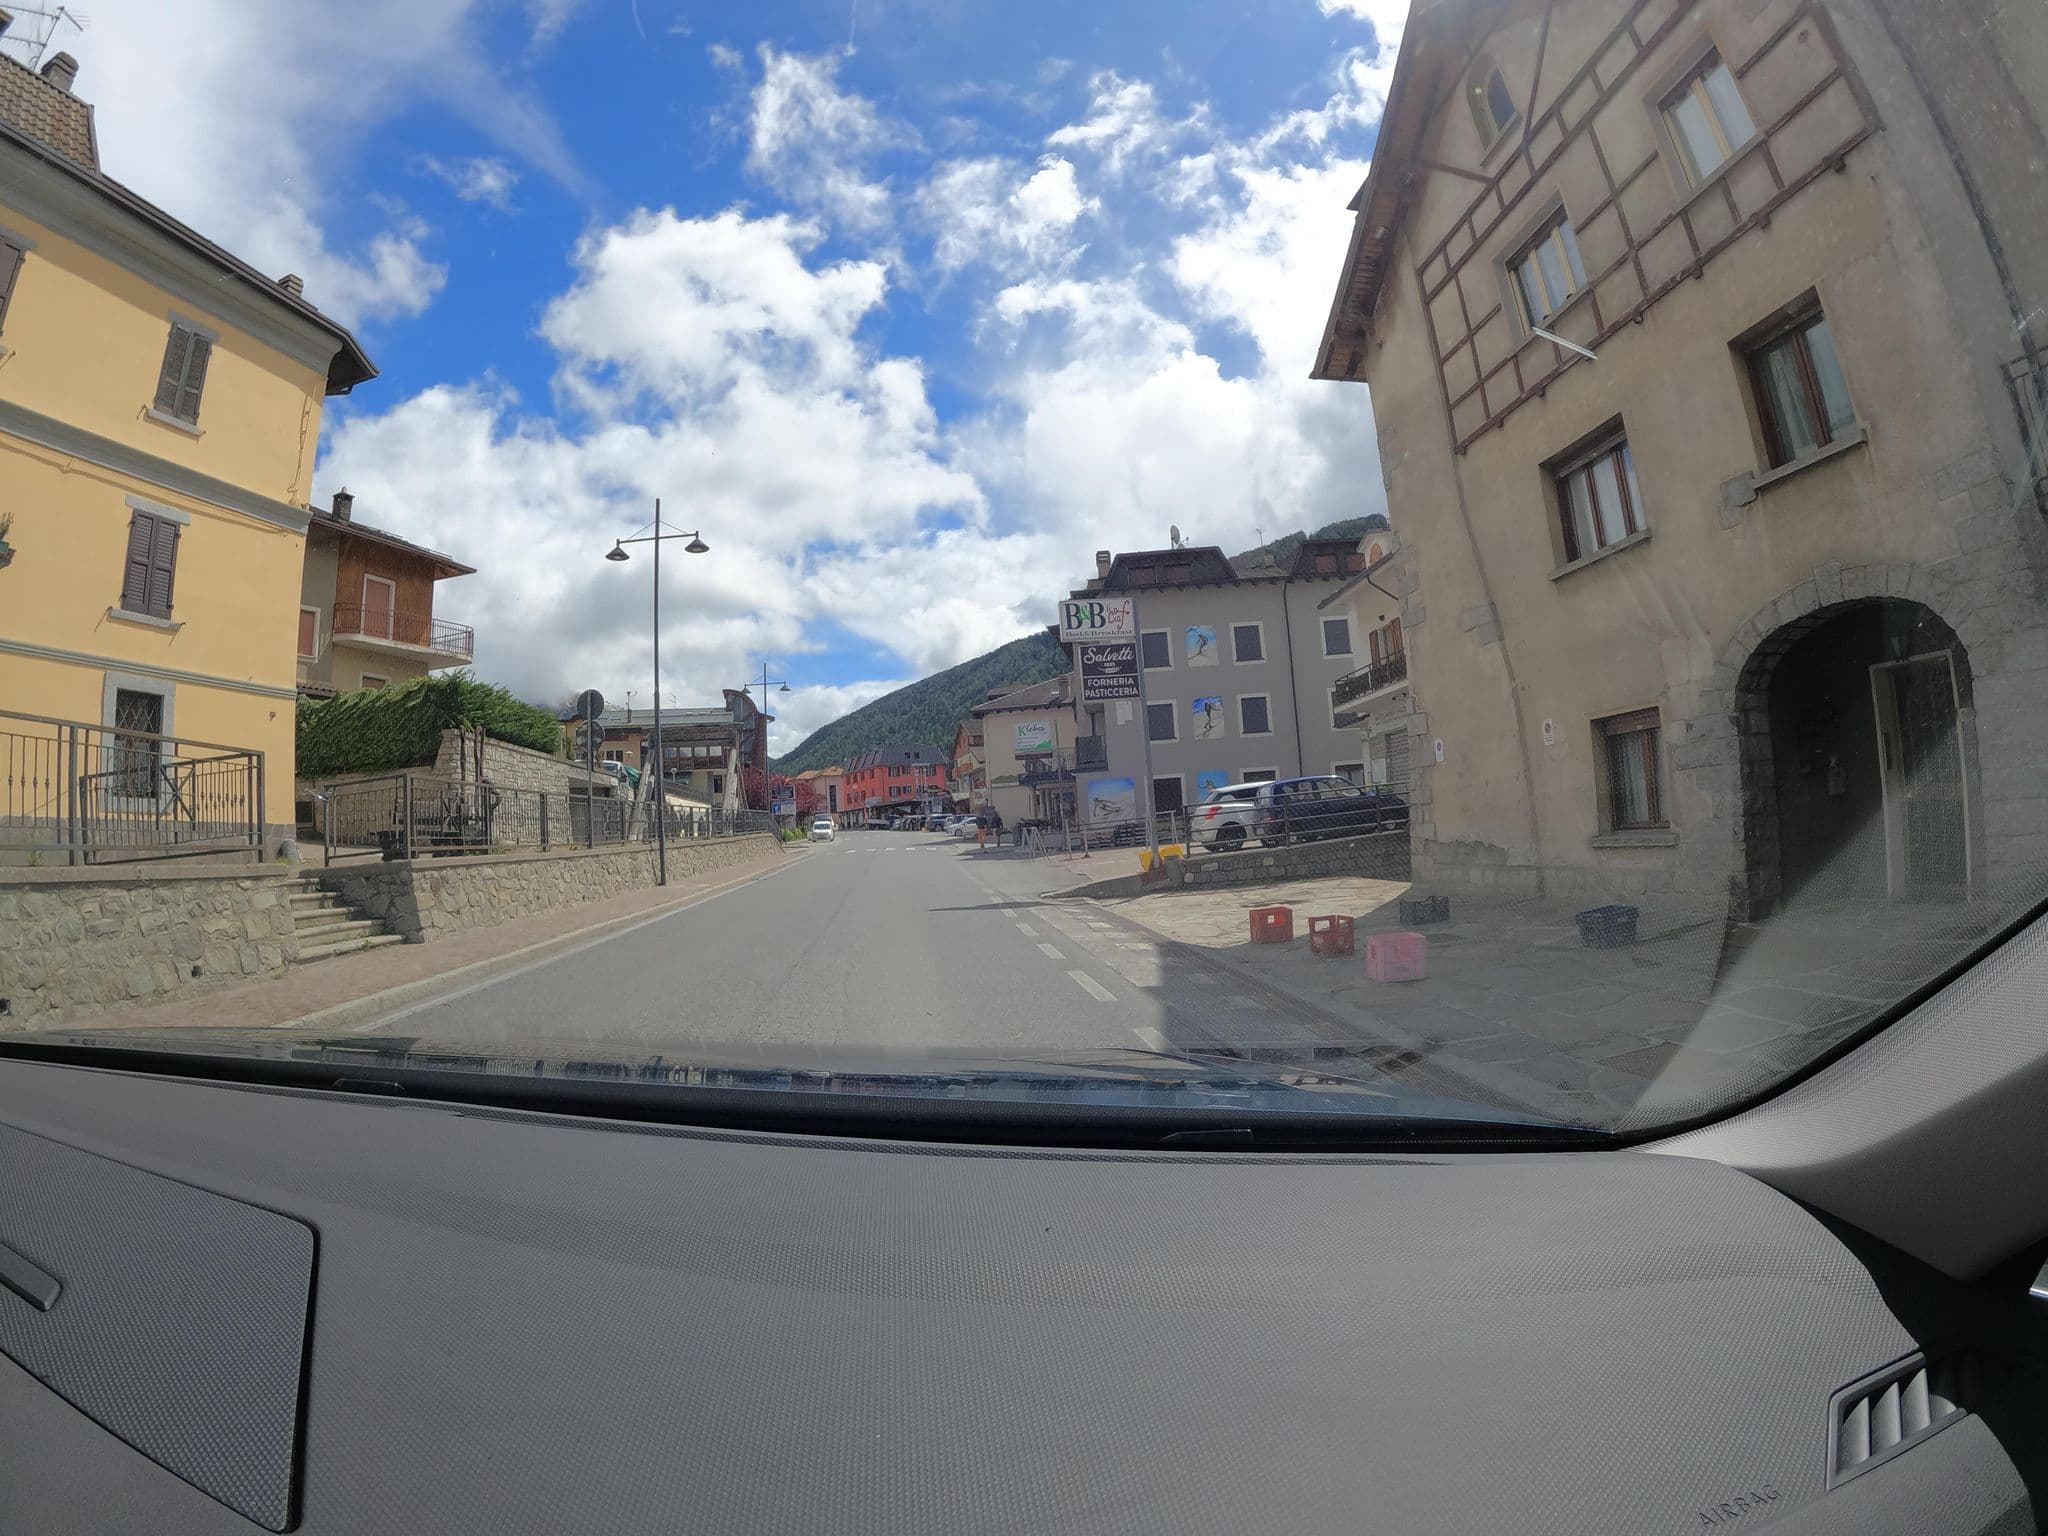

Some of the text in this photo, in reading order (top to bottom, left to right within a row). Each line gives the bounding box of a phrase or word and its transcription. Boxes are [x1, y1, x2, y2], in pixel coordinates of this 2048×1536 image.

[1065, 602, 1106, 630] B&B
[1084, 646, 1135, 664] Salvetti
[1088, 678, 1134, 687] FORNERIA
[1085, 687, 1138, 697] PASTICCERIA
[1698, 1484, 1782, 1528] AIRBAG
